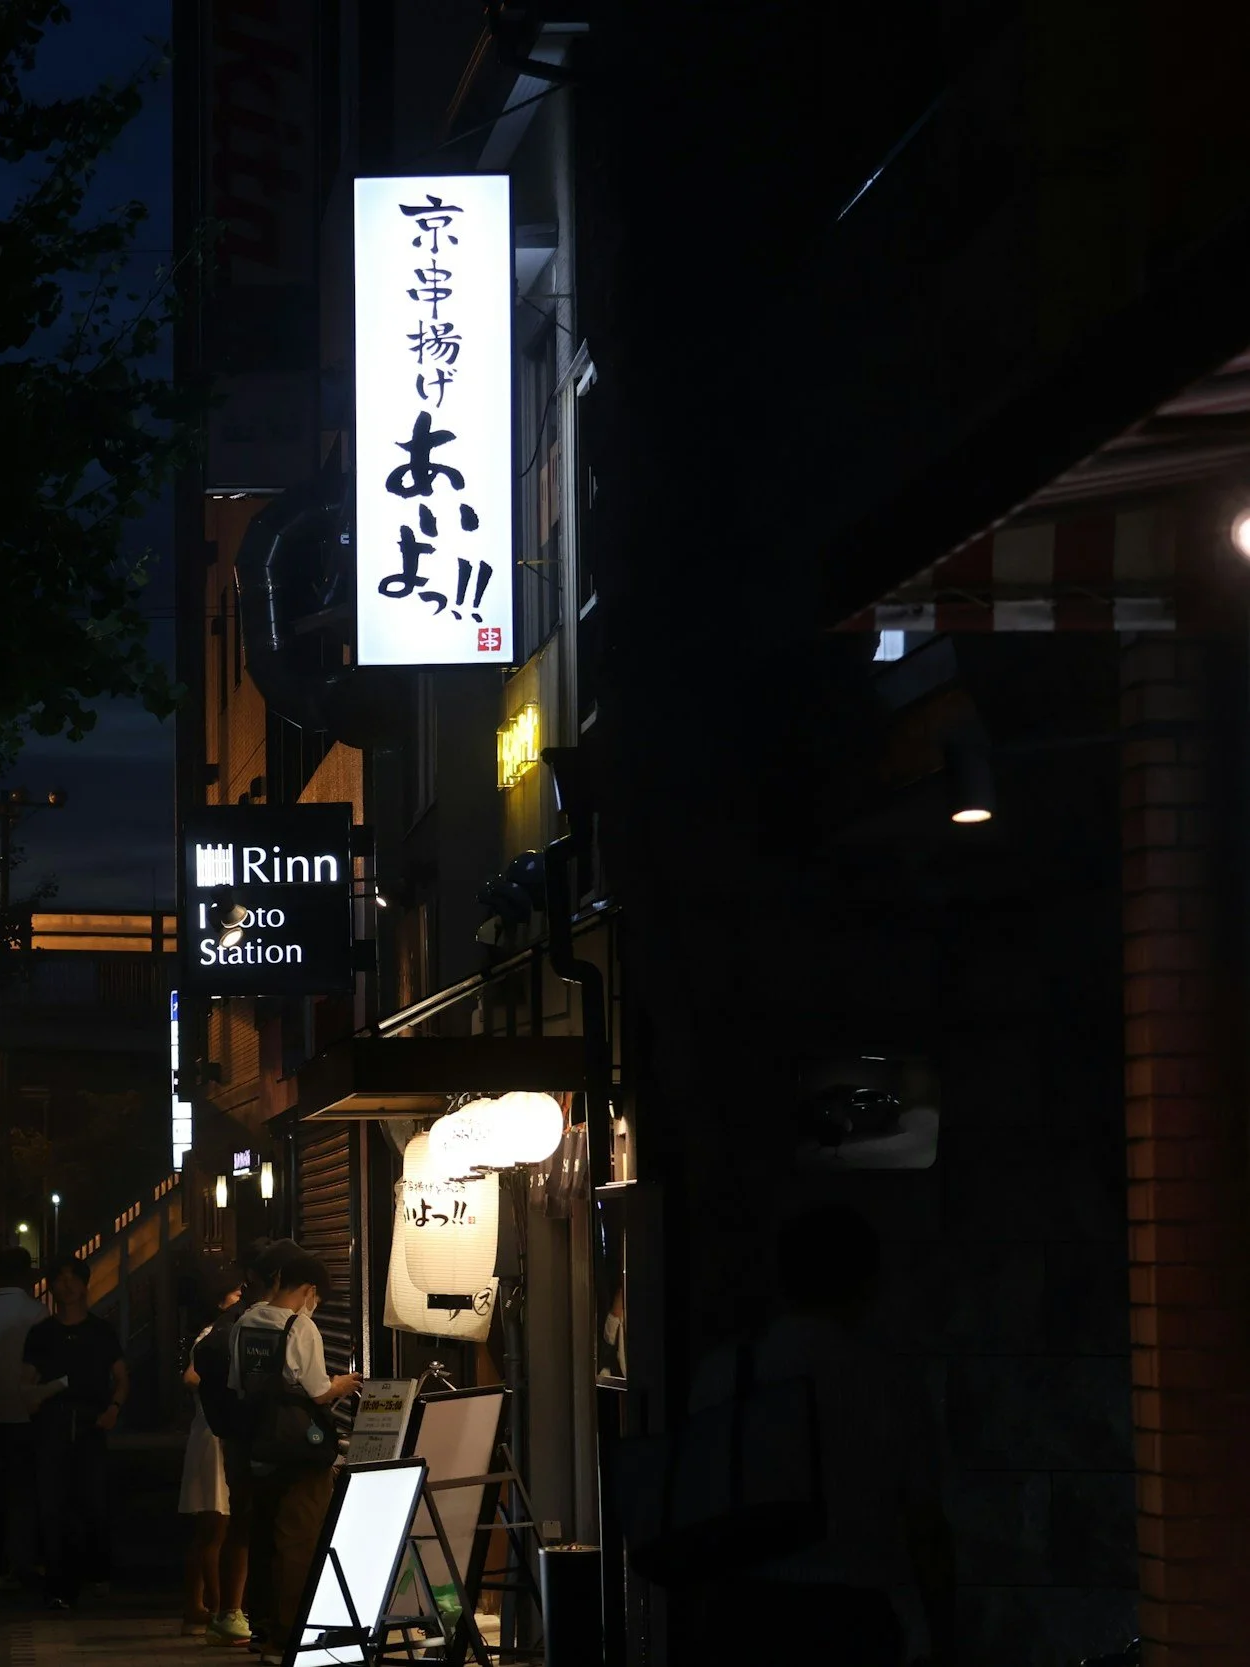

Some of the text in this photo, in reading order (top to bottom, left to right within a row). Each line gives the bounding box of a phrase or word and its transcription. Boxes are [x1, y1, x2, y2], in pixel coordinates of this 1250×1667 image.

[399, 195, 463, 407] 京串揚げ
[243, 846, 337, 883] Rinn
[200, 936, 301, 965] Station
[403, 1198, 468, 1227] いよっ!!
